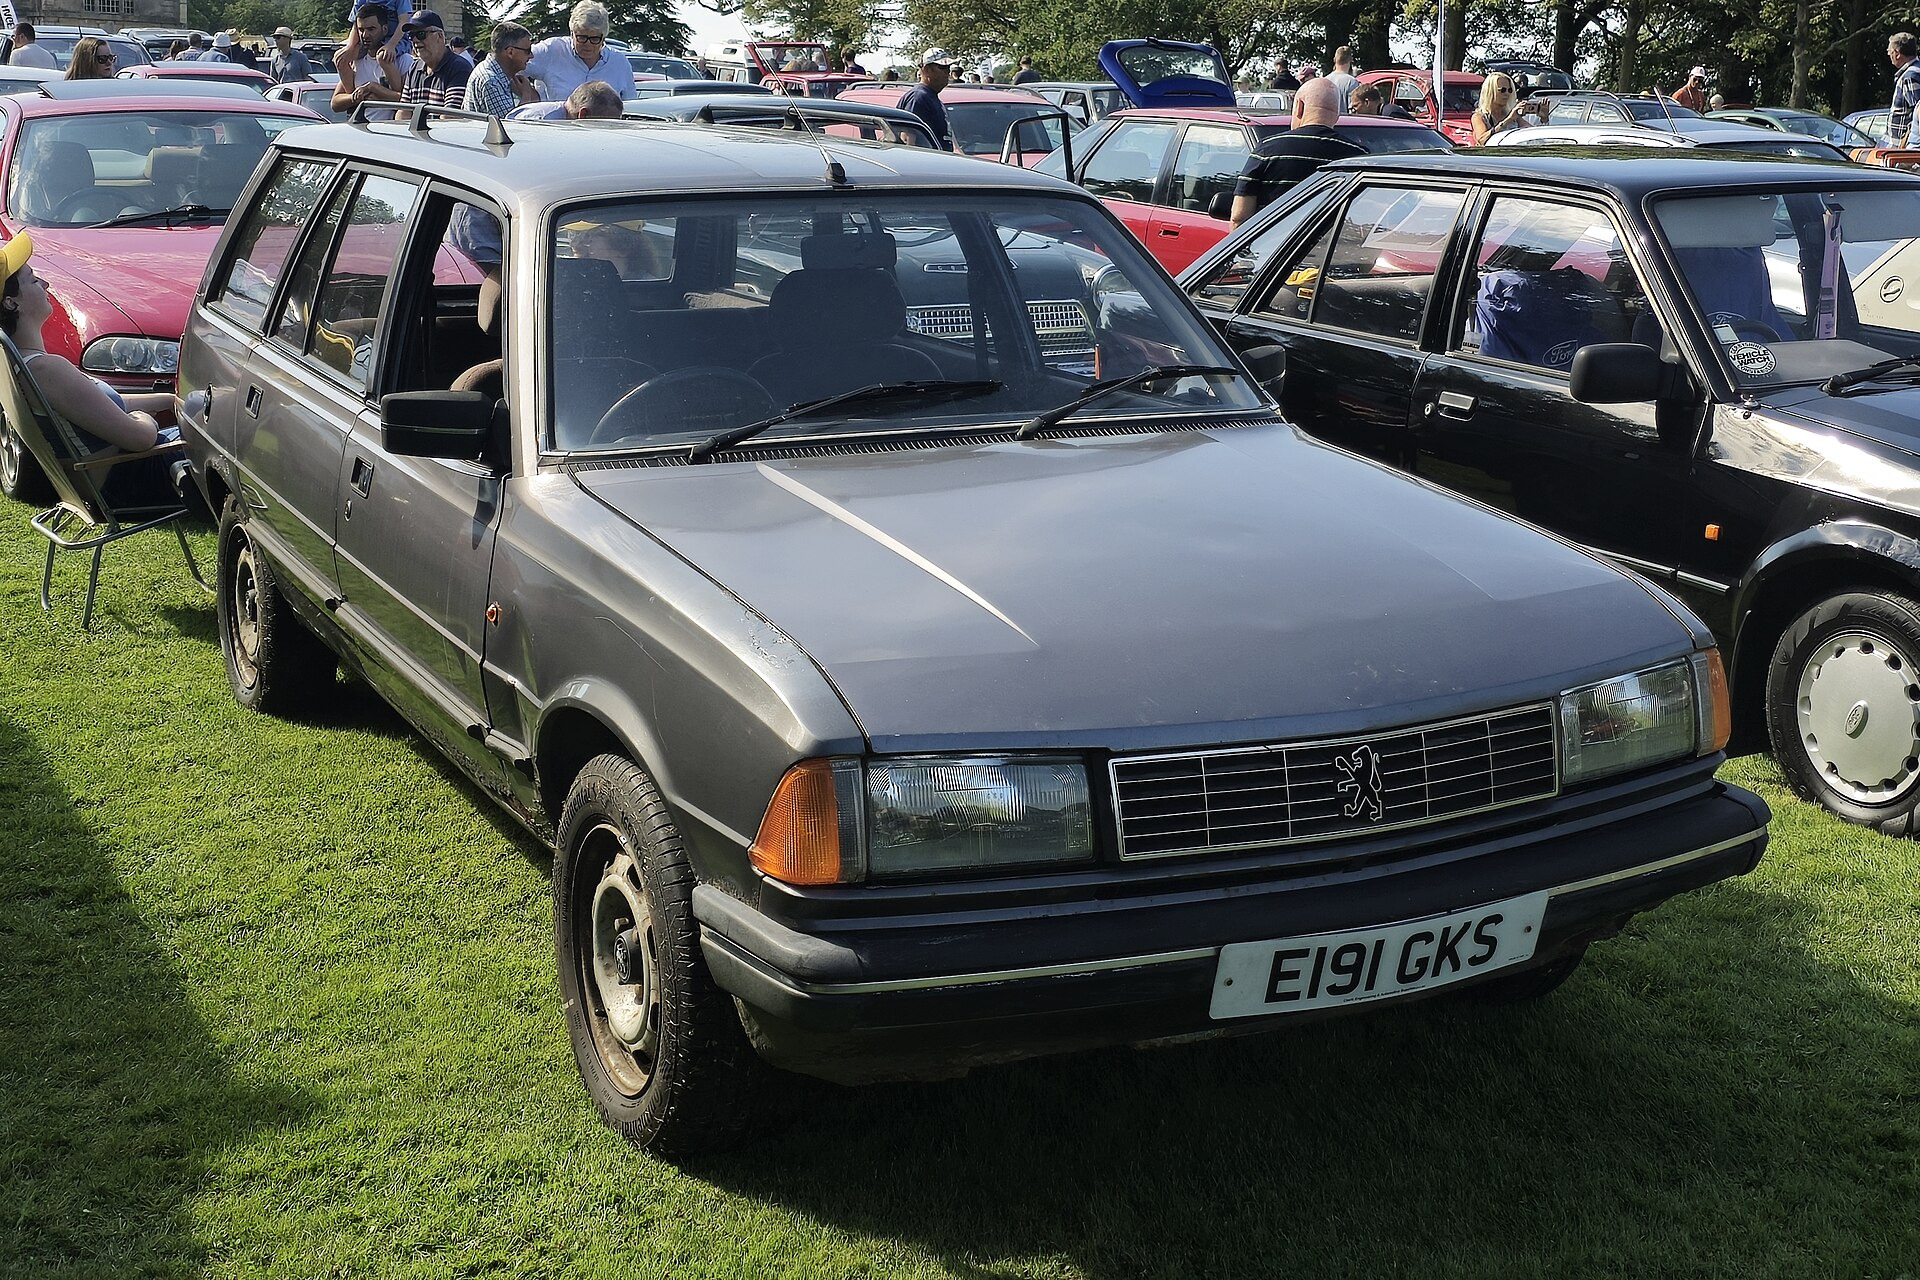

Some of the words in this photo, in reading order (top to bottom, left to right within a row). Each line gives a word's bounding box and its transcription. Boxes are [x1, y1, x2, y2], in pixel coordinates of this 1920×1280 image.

[1730, 350, 1770, 361] VEHICLE
[1738, 356, 1770, 366] WATCH
[1264, 938, 1386, 1004] E191
[1396, 913, 1504, 985] GKS
